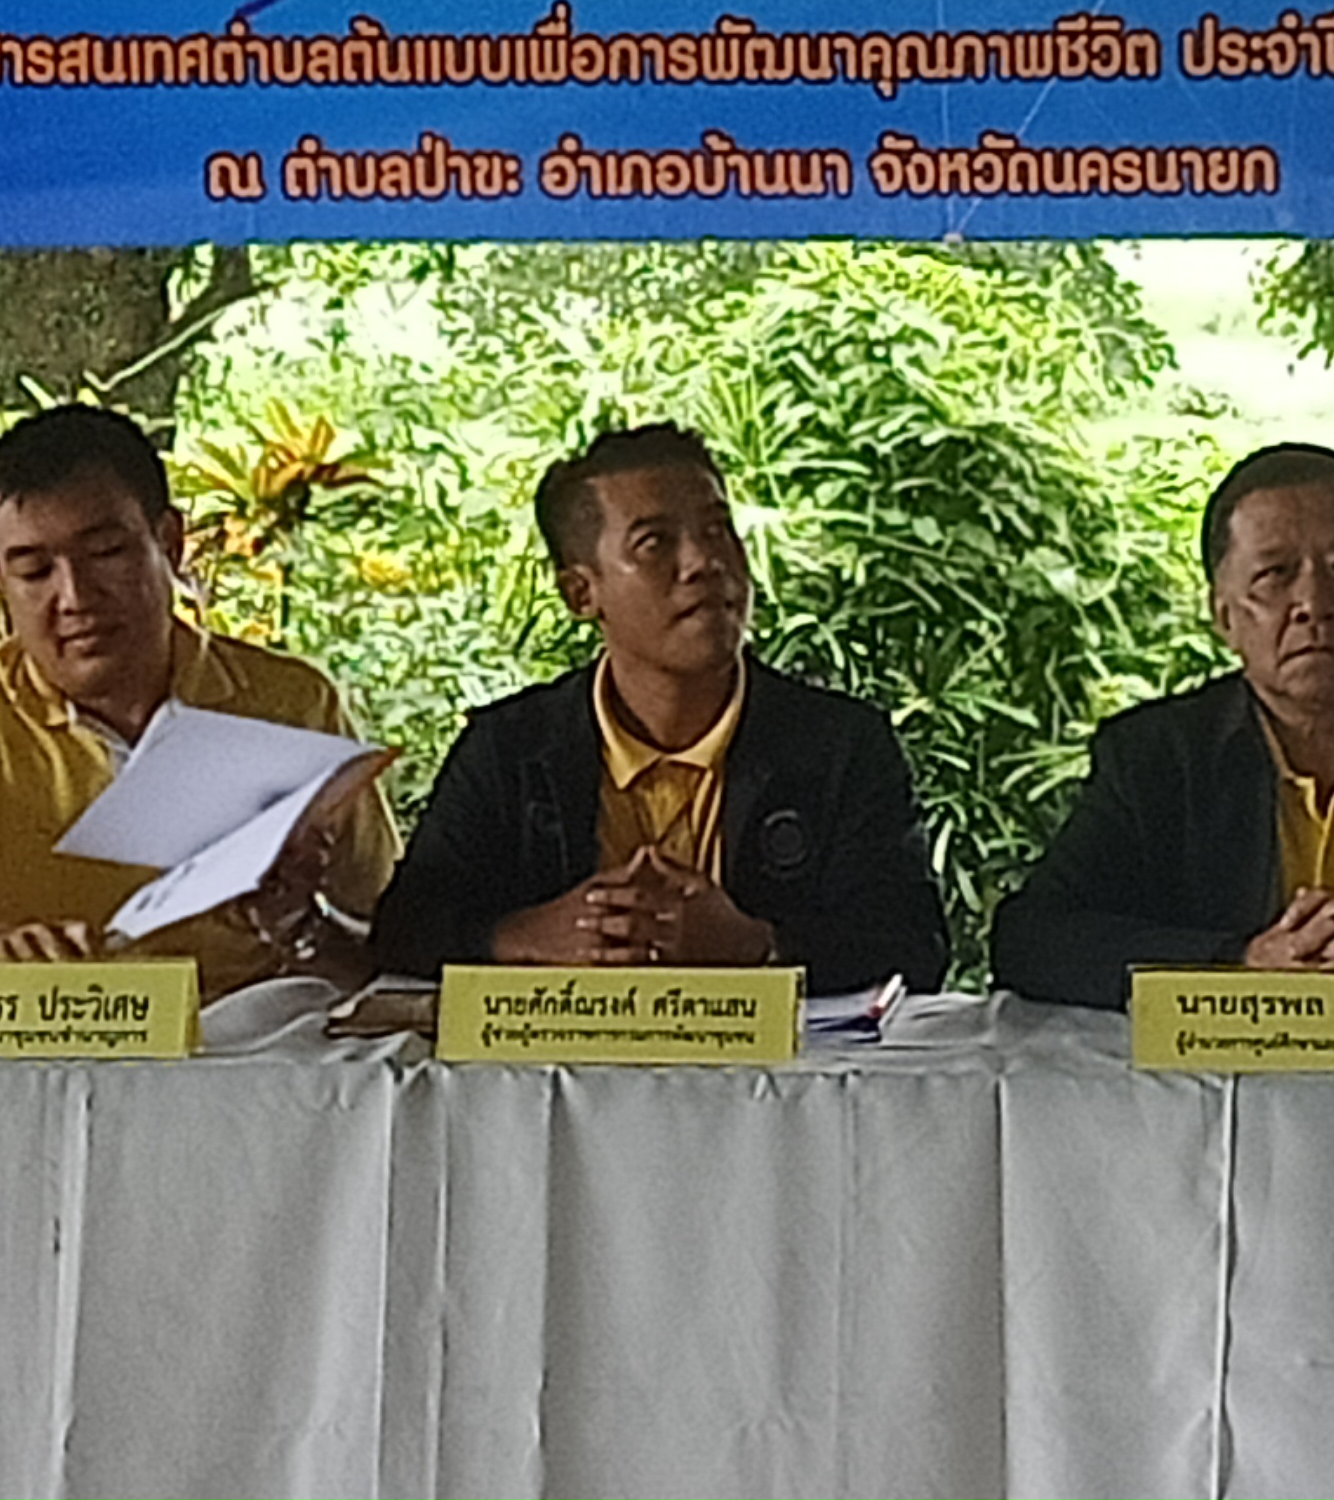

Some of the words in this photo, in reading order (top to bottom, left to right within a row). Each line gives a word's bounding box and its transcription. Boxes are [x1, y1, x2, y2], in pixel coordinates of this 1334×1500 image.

[205, 150, 264, 200] ณ
[281, 129, 522, 202] ตำบลป่าขะ
[539, 130, 853, 202] อำเภอบ้านนา
[871, 129, 1280, 200] จังหวัดนครนายก
[38, 983, 150, 1023] ประวิเศษ
[1175, 992, 1326, 1026] นายสุรพล
